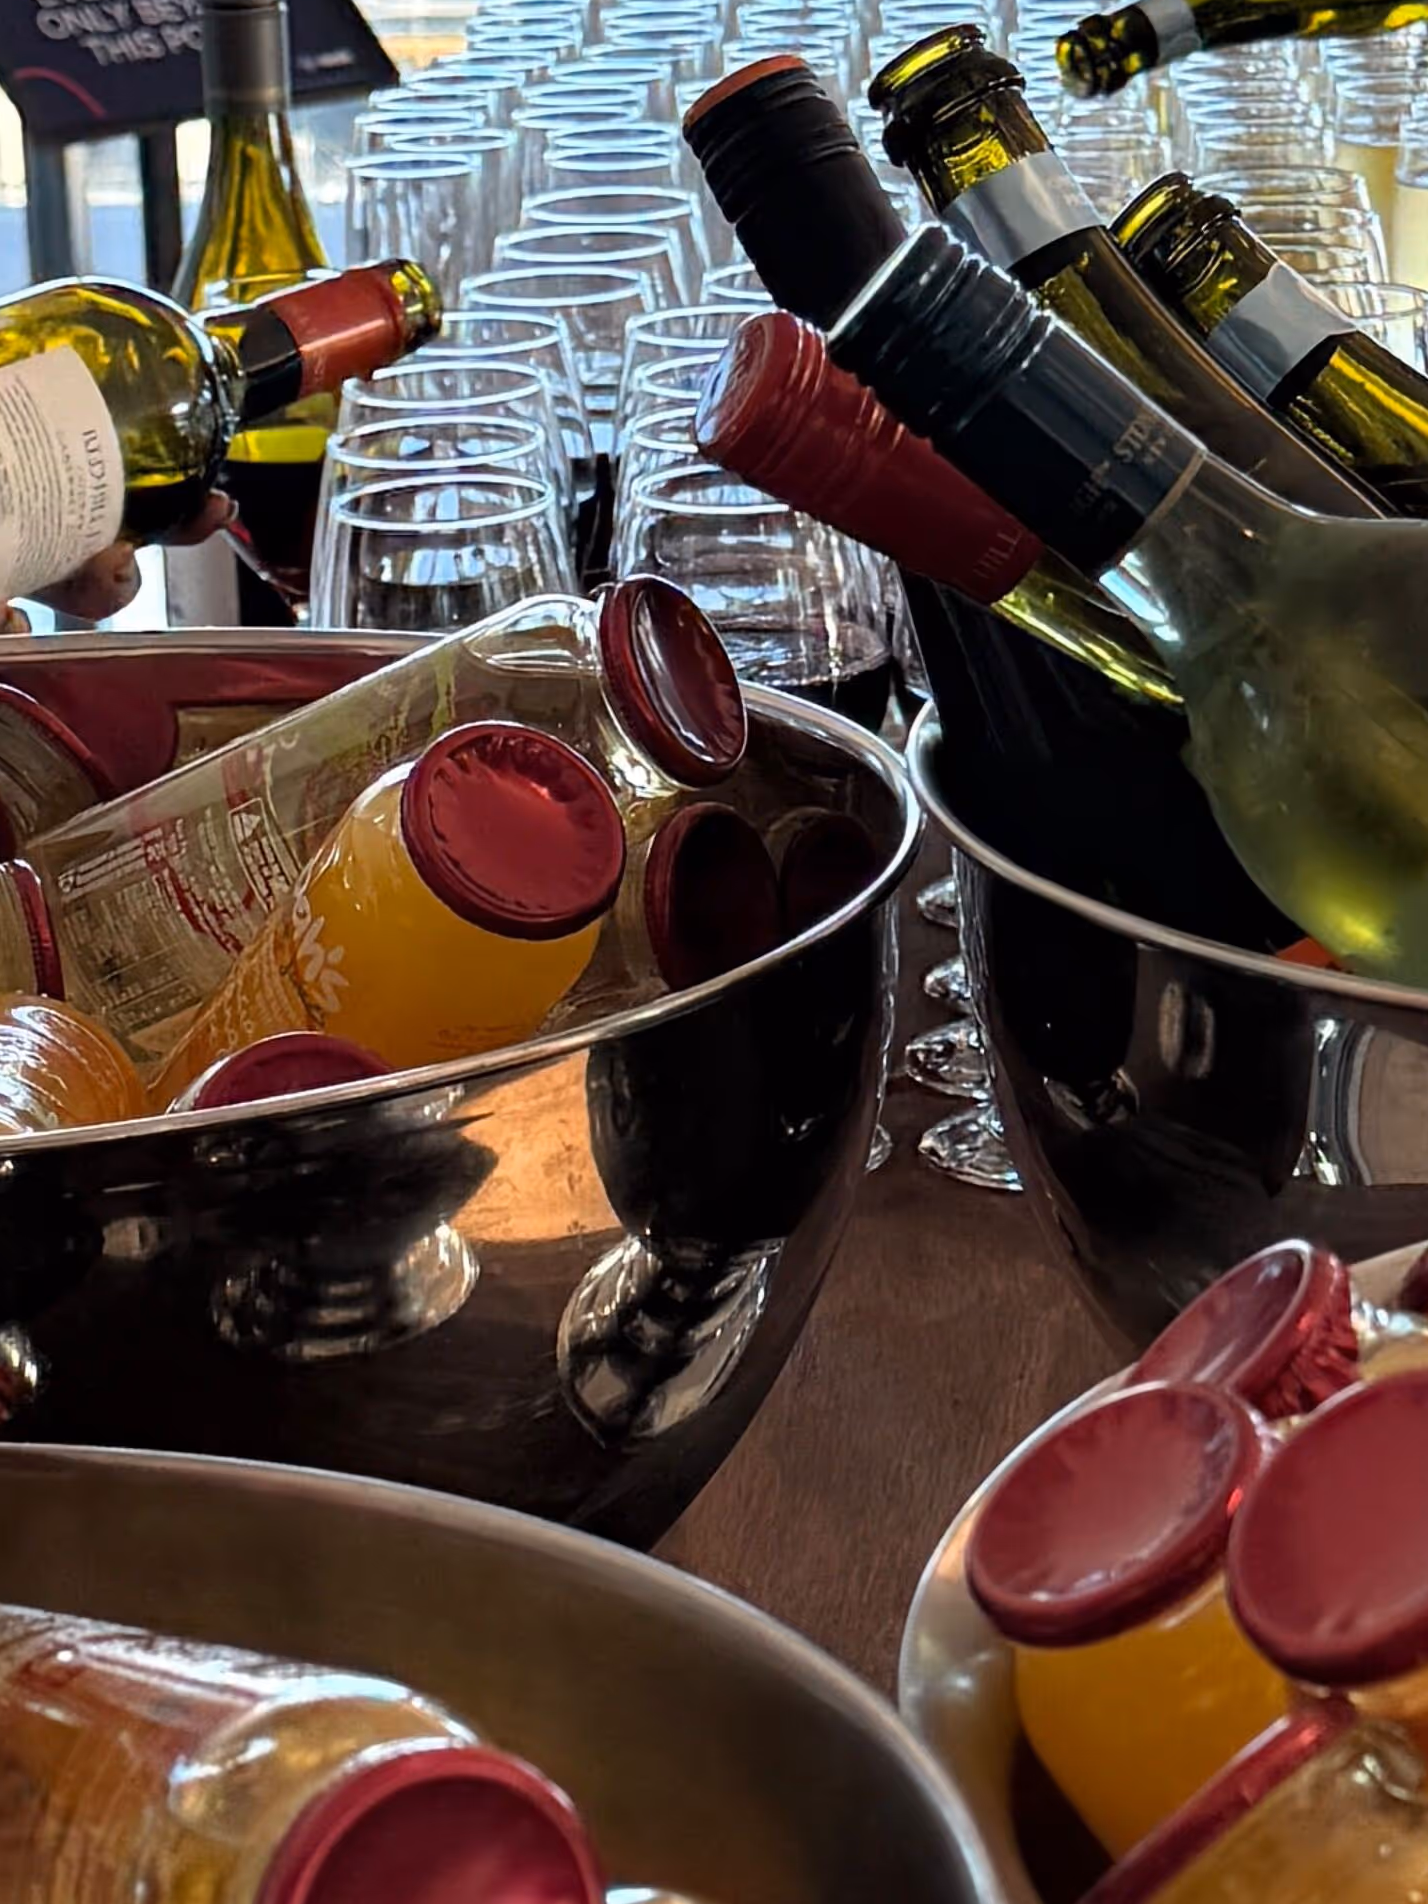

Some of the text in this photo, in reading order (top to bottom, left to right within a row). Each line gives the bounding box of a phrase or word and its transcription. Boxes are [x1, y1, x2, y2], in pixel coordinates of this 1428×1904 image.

[36, 0, 130, 40] ONLY
[79, 22, 204, 67] THIS PO
